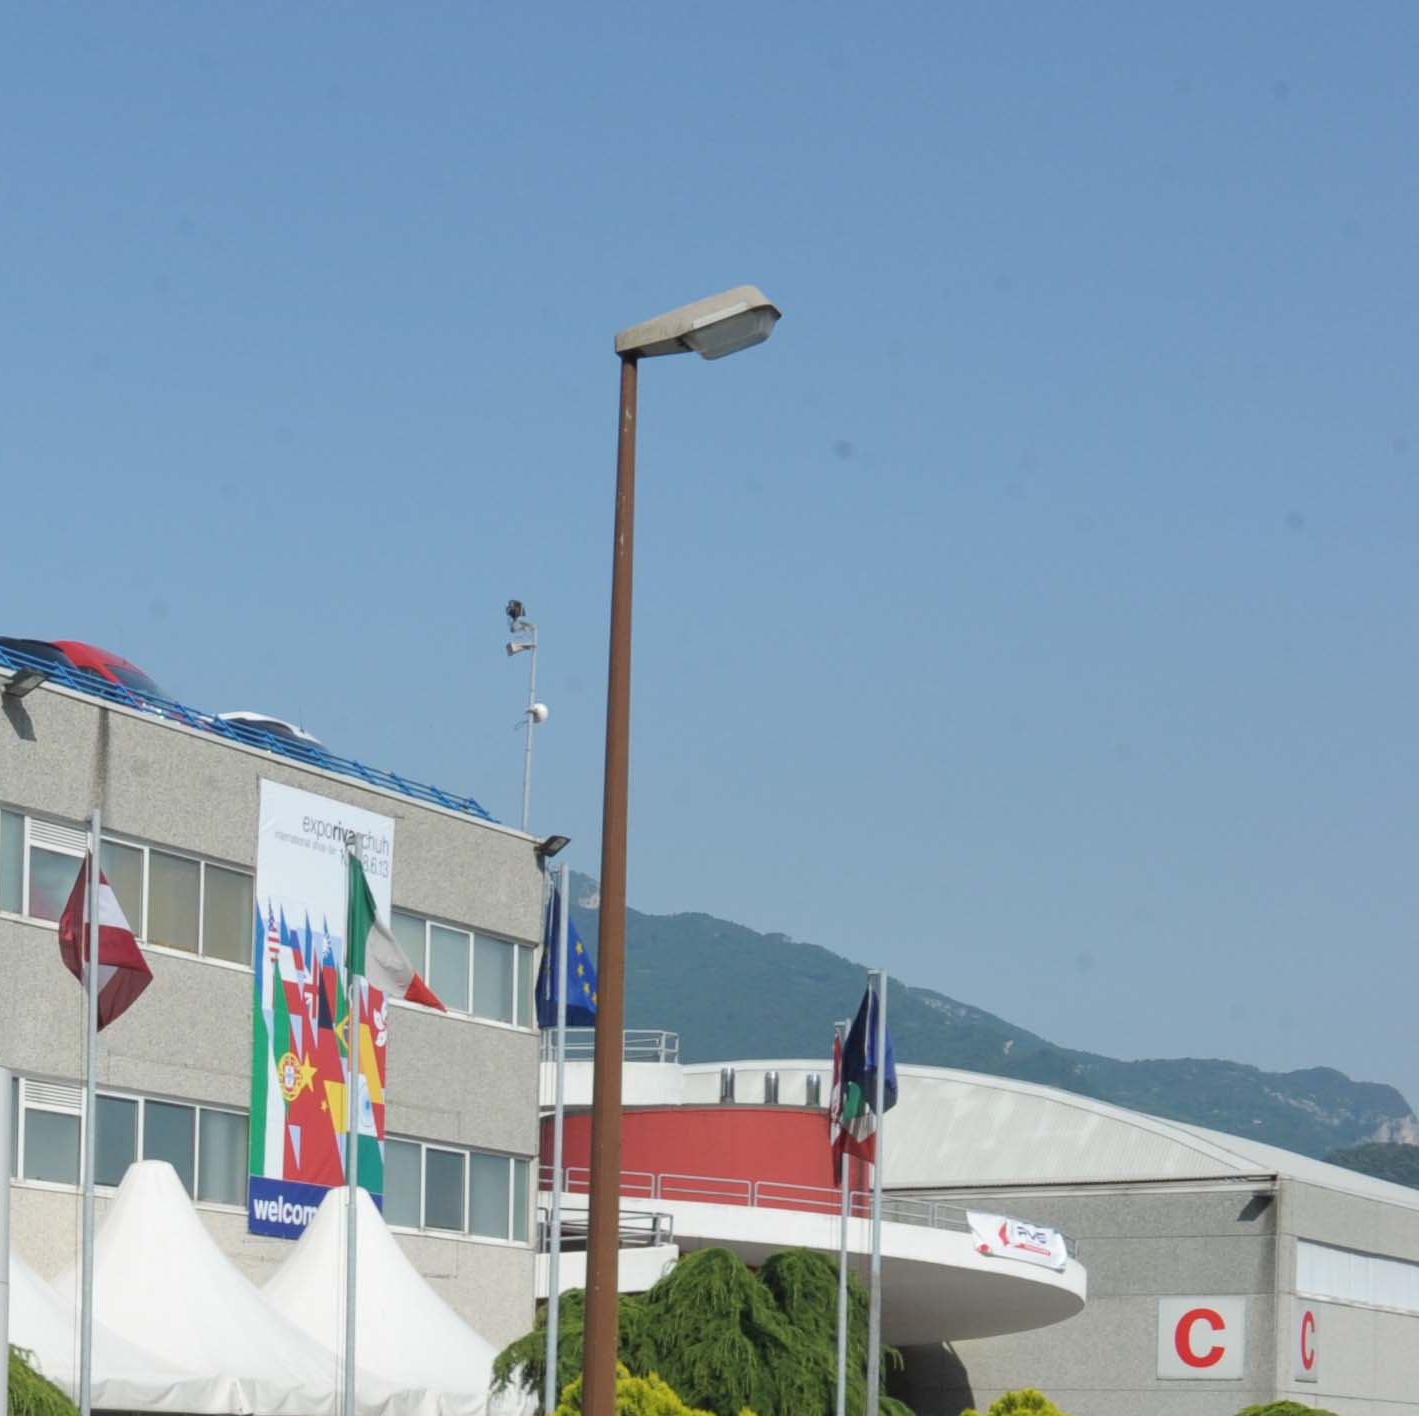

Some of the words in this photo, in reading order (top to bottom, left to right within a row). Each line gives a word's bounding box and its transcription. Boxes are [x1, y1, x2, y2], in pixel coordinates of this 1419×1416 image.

[254, 1195, 318, 1226] welcom
[1174, 1307, 1226, 1368] C
[1300, 1310, 1316, 1371] C
